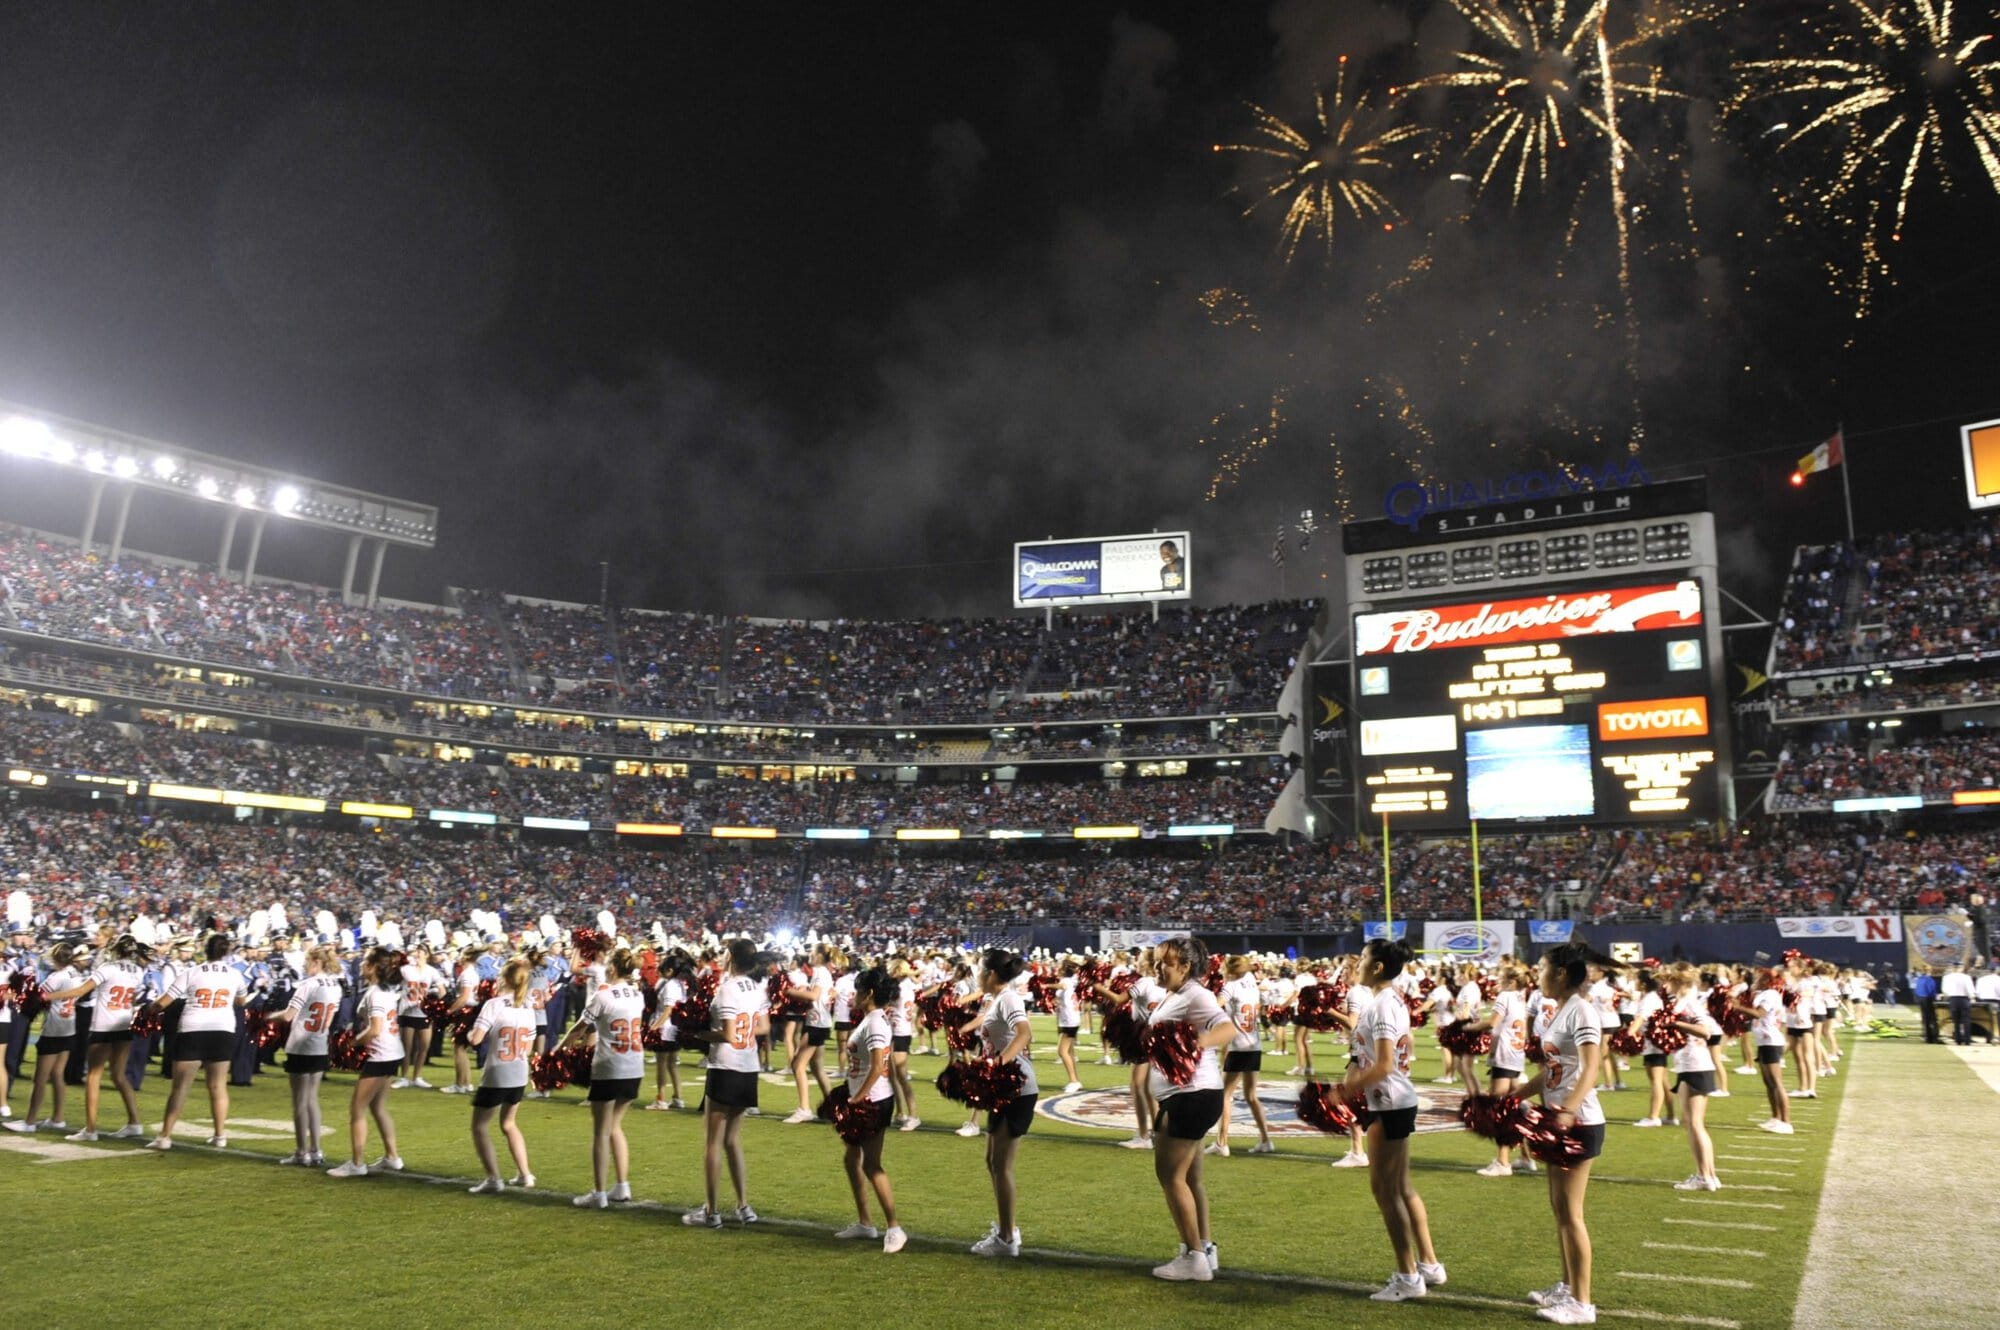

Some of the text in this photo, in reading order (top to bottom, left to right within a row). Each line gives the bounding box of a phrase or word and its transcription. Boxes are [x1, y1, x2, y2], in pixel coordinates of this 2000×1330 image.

[1438, 496, 1631, 531] STADIUM
[1023, 560, 1099, 578] QUALCOMM
[1390, 593, 1613, 654] Budweiser
[1603, 707, 1703, 732] TOYOTA
[1312, 728, 1348, 742] Sprint
[1864, 918, 1892, 940] N
